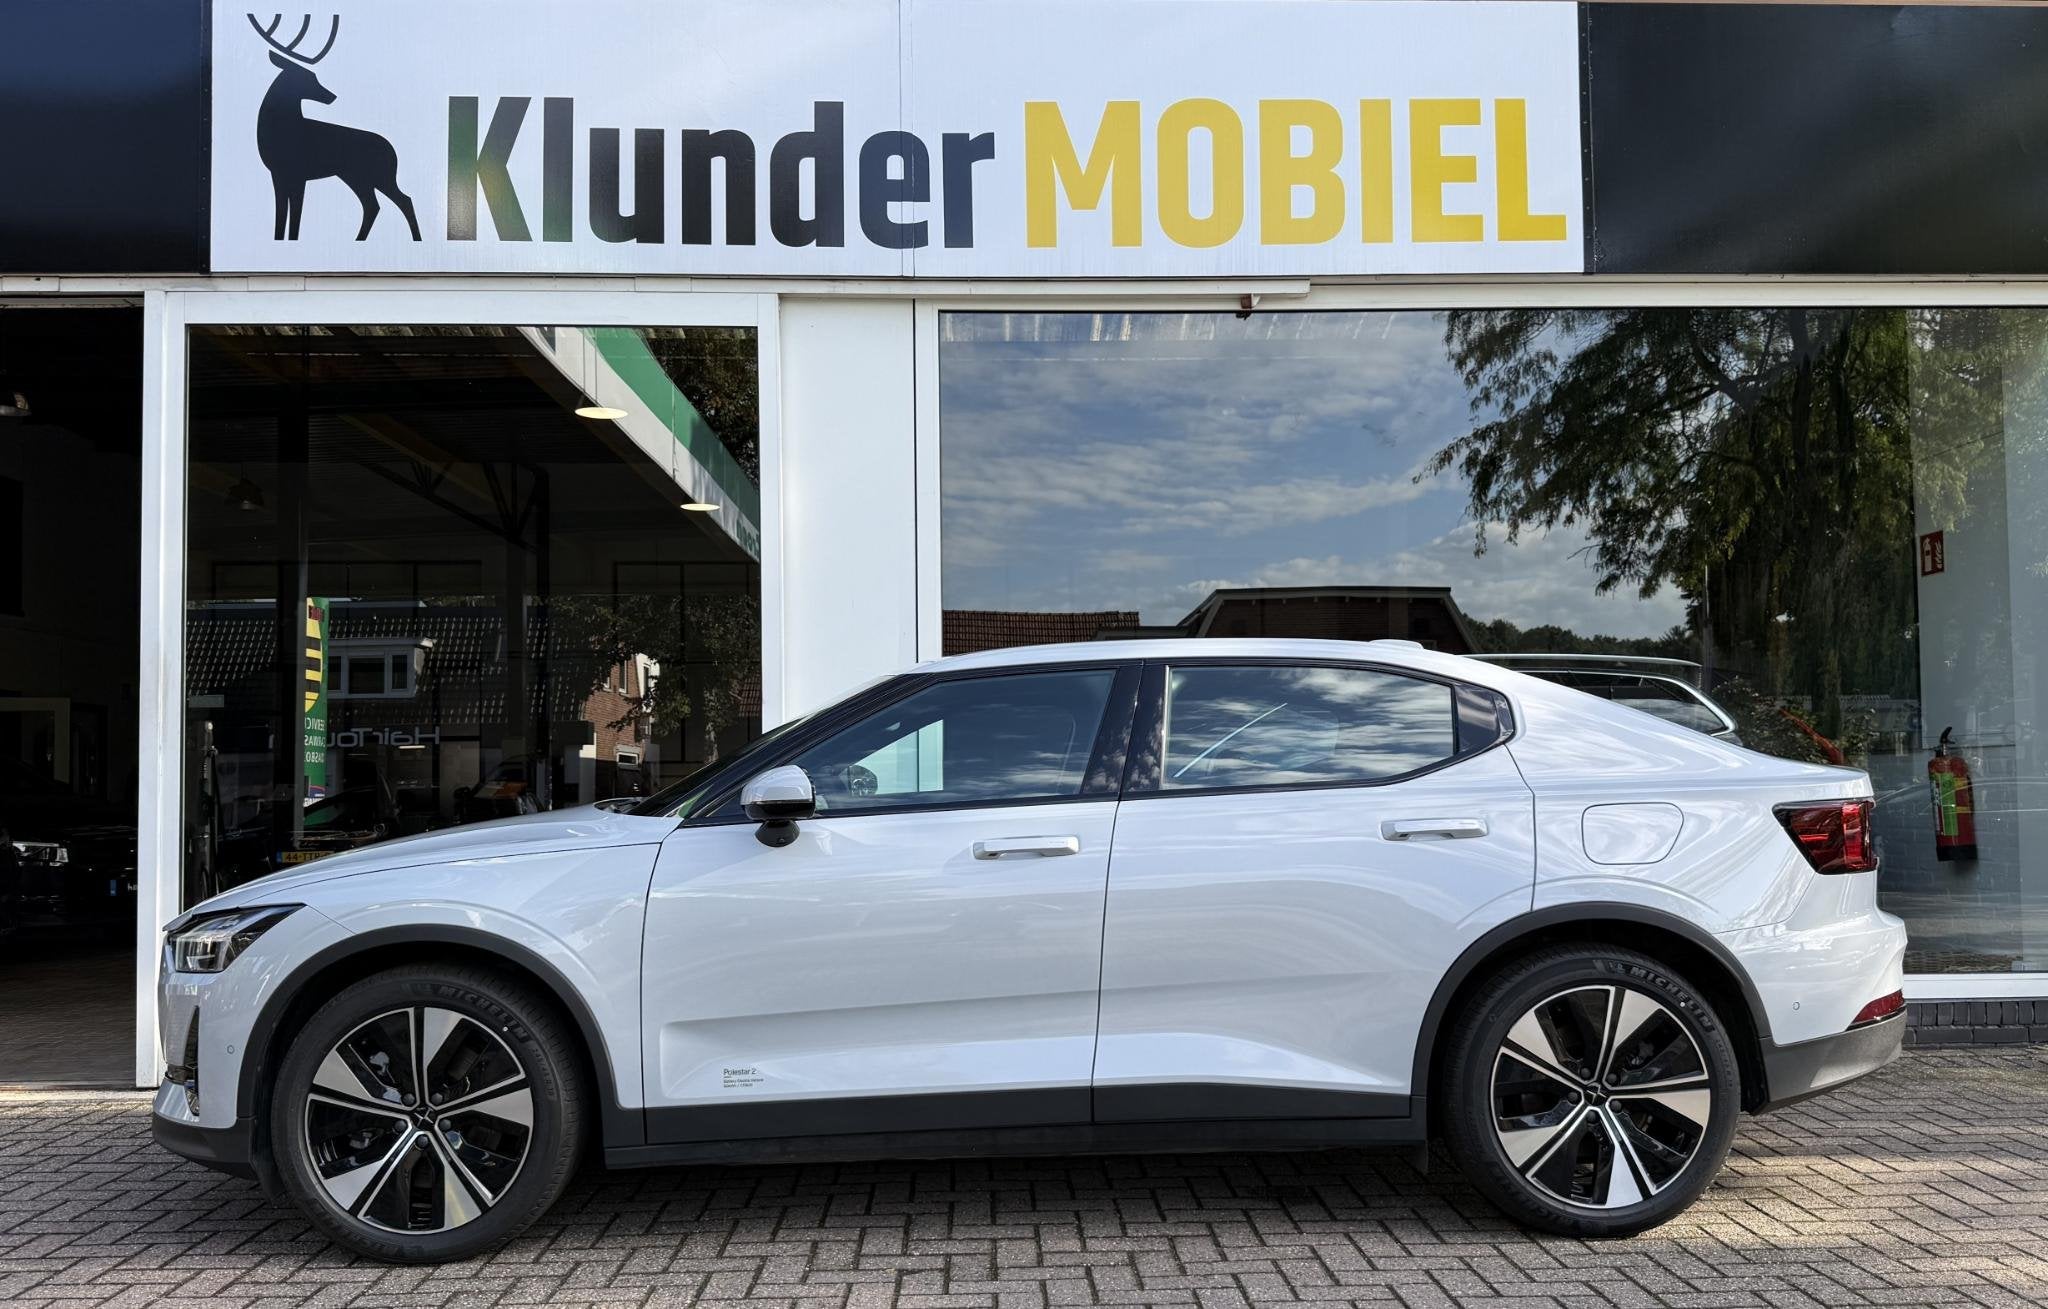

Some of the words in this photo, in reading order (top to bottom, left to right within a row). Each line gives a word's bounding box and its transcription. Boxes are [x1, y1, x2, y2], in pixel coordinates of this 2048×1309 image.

[447, 96, 995, 249] Klunder
[1024, 97, 1567, 249] MOBIEL
[438, 985, 532, 1043] MICHELIN
[1629, 965, 1716, 1033] MICHELIN
